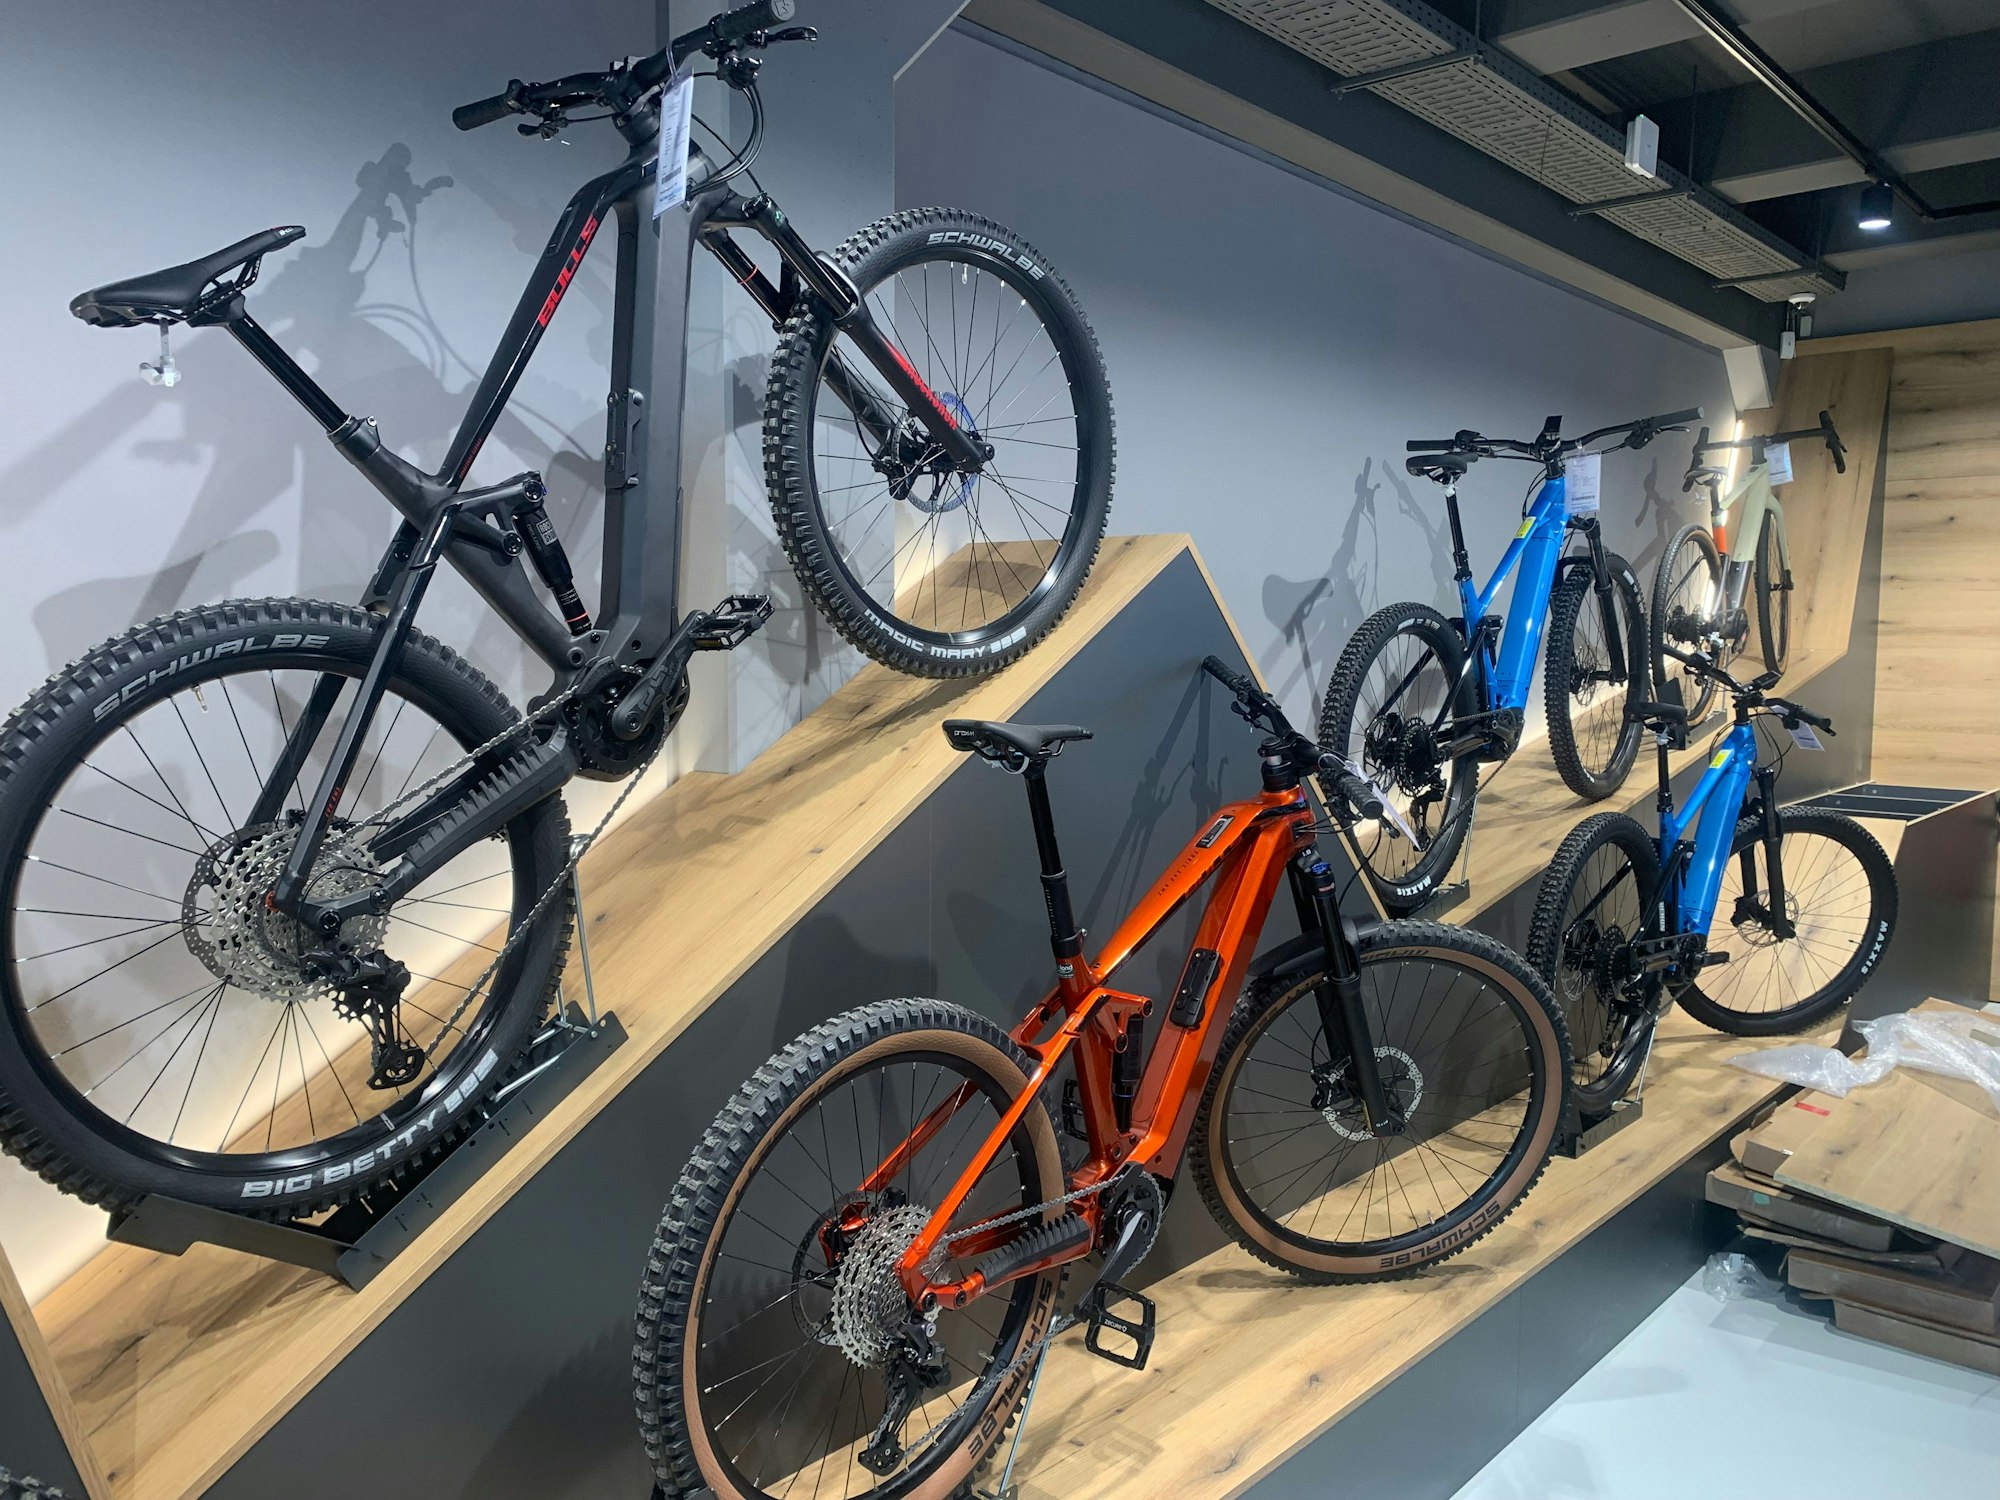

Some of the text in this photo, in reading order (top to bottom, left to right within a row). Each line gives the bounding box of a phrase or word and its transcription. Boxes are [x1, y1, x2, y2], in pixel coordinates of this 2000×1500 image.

[538, 213, 598, 328] BULLS
[926, 231, 1045, 281] SCHWALBE
[864, 608, 985, 660] MAGIC MARY
[92, 633, 331, 723] SCHWALBE
[1396, 875, 1432, 897] MAXXIS
[1861, 919, 1889, 975] MAXXIS
[240, 1108, 437, 1198] BIG BETTY
[1379, 1200, 1500, 1269] SCHWALBE
